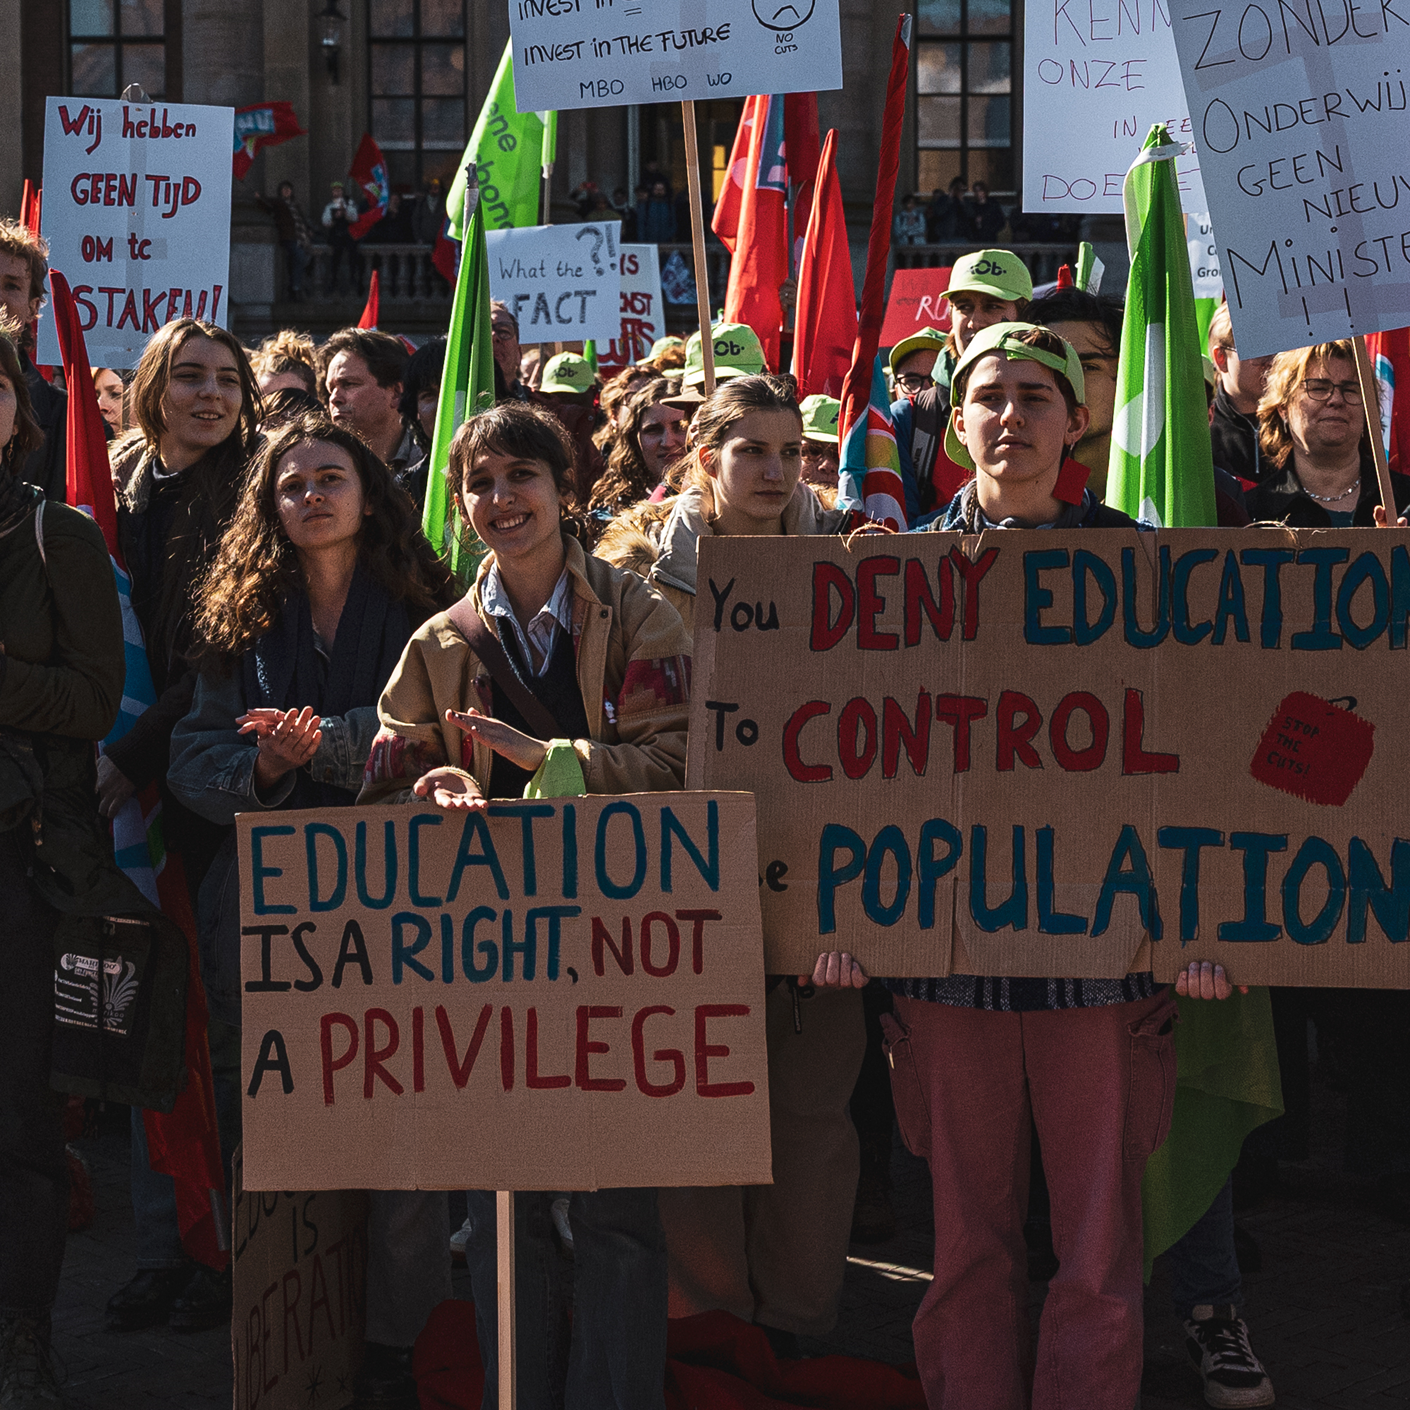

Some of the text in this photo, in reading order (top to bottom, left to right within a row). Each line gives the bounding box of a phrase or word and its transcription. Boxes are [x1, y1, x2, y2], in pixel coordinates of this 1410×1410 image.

[612, 34, 653, 56] THE
[655, 22, 732, 53] FUTURE
[578, 72, 732, 99] MBO HBO WO
[1037, 58, 1148, 91] ONZE
[58, 105, 102, 155] Wij
[122, 105, 197, 139] hebben
[1113, 115, 1138, 139] IN
[1237, 145, 1344, 197] GEEN
[71, 173, 137, 206] GEEN
[81, 234, 114, 263] OM
[498, 257, 583, 279] What the
[512, 290, 597, 325] FACT
[708, 576, 780, 632] You
[808, 545, 1001, 651] DENY
[705, 686, 1180, 782] To CONTROL
[1282, 716, 1320, 739] STOP
[250, 800, 720, 916] EDUCATION
[817, 817, 1410, 947] POPULATION
[242, 904, 722, 992] IS A RIGHT, NOT
[246, 1028, 295, 1098] A
[320, 1003, 756, 1107] PRIVILEGE
